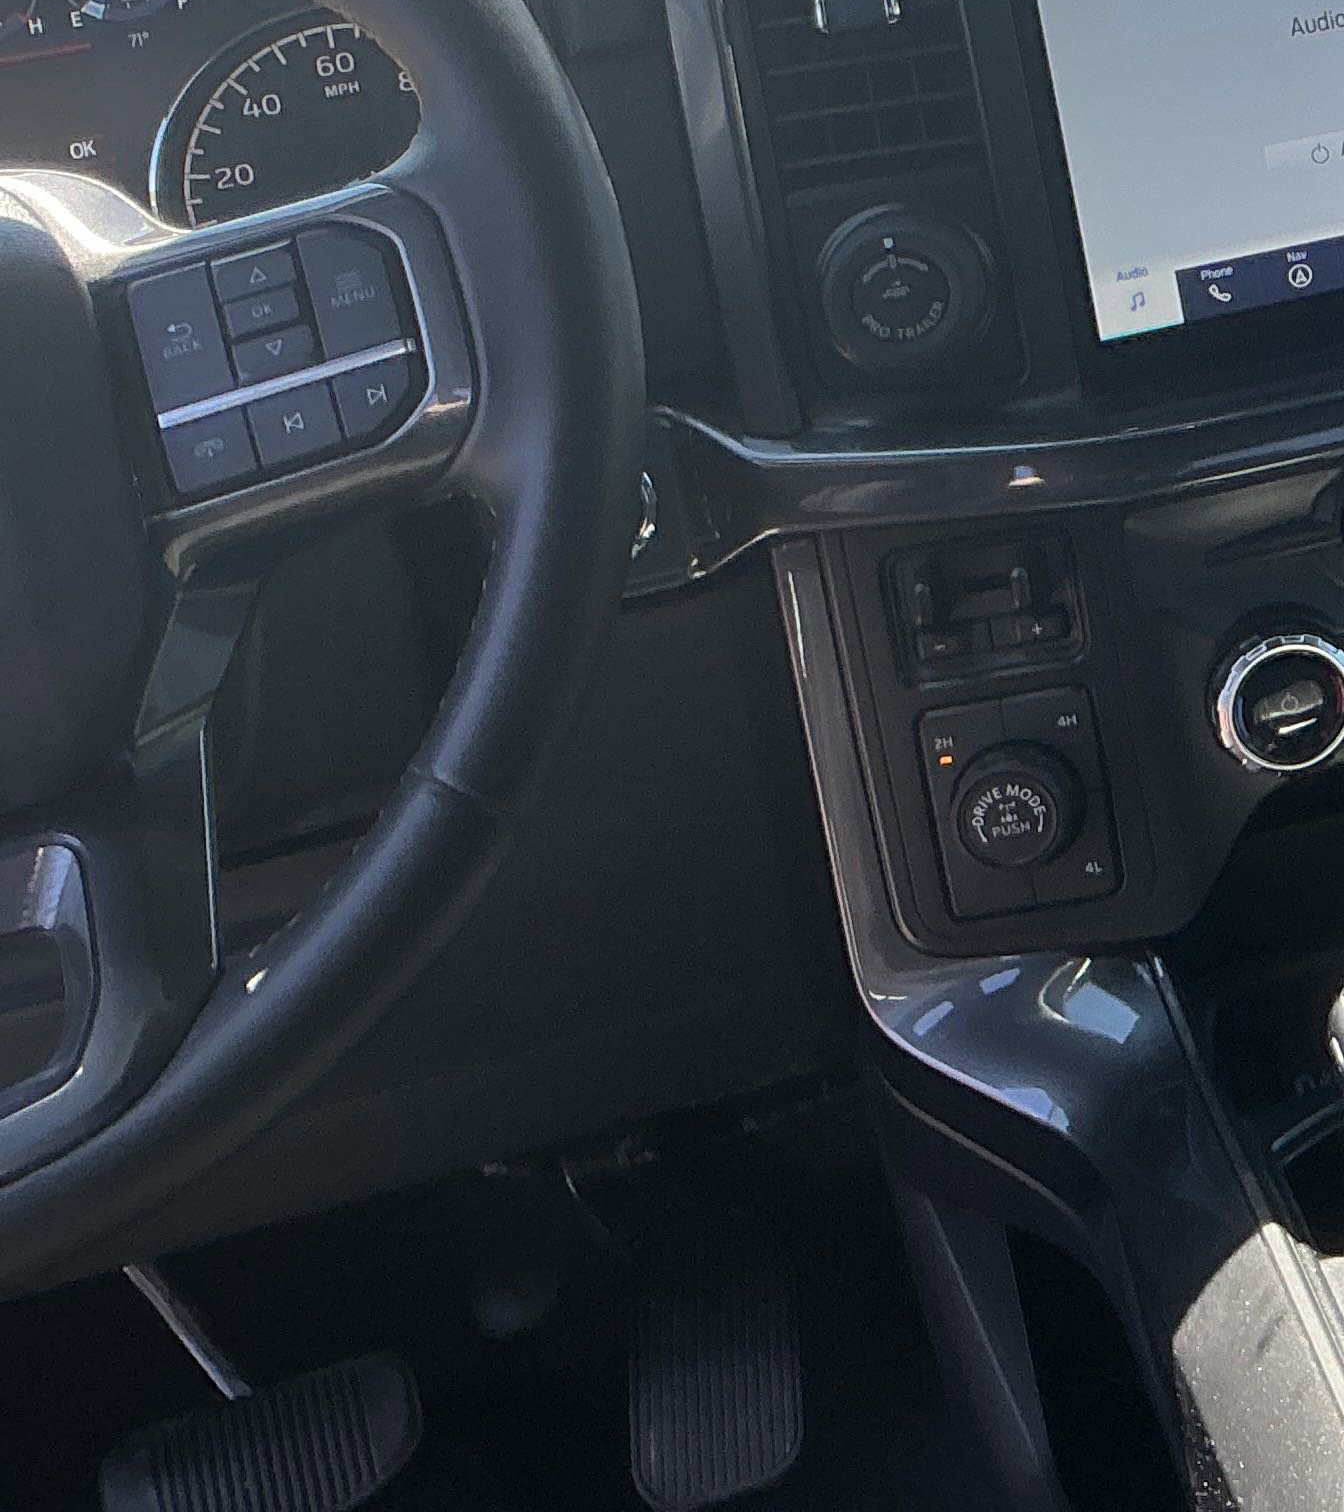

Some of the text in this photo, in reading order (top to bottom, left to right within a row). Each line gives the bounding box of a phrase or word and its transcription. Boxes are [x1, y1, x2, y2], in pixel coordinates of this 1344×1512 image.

[28, 19, 45, 35] H
[70, 11, 84, 28] E
[315, 52, 355, 77] 60
[324, 81, 361, 99] MPH
[242, 93, 282, 118] 40
[69, 137, 97, 160] OK
[215, 163, 255, 190] 20
[1286, 250, 1308, 263] Nav
[1116, 266, 1149, 282] Audio
[1200, 265, 1234, 281] Phone
[330, 285, 376, 310] MENU
[1056, 714, 1079, 729] 4H
[972, 783, 1048, 827] DRIVE MODE
[992, 820, 1031, 839] PUSH
